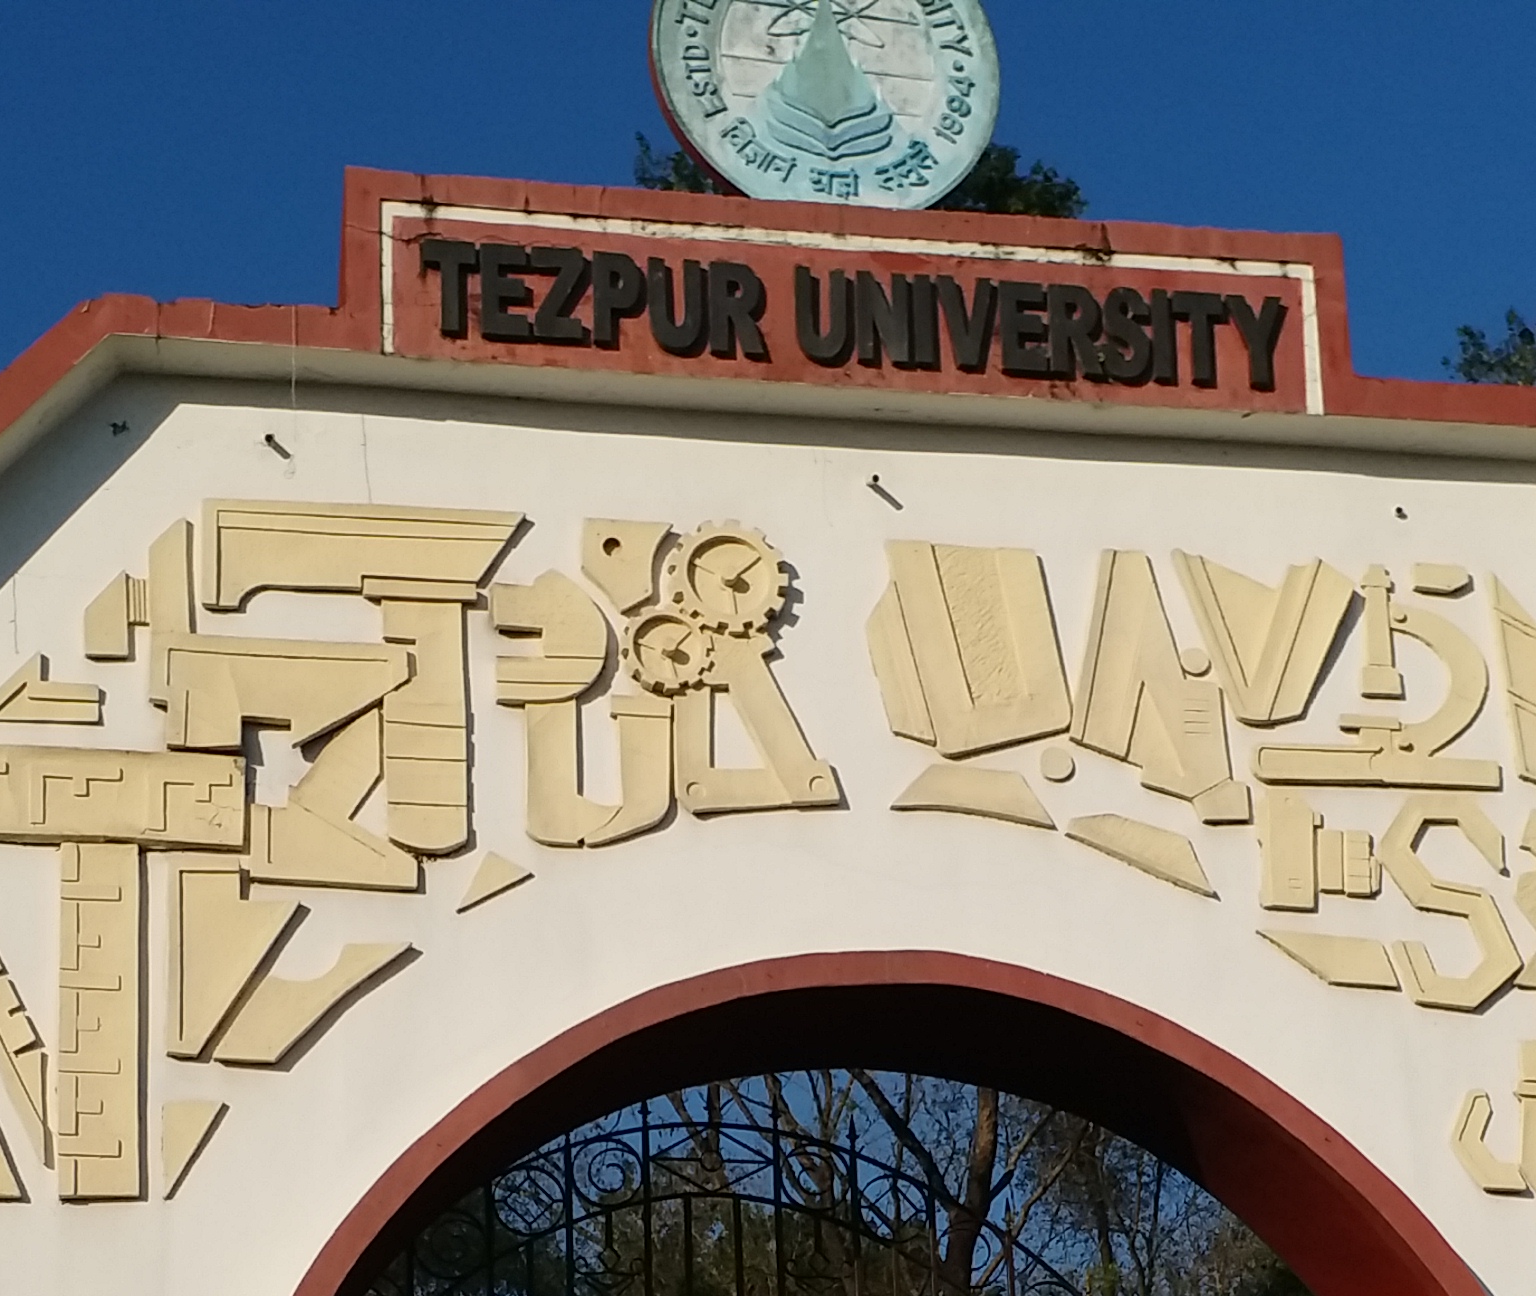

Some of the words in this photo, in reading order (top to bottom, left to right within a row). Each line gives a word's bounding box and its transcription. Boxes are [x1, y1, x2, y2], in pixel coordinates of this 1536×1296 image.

[681, 44, 728, 119] ESTD
[931, 75, 977, 145] 1994
[420, 237, 772, 363] TEZPUR
[796, 265, 1290, 393] UNIVERSITY
